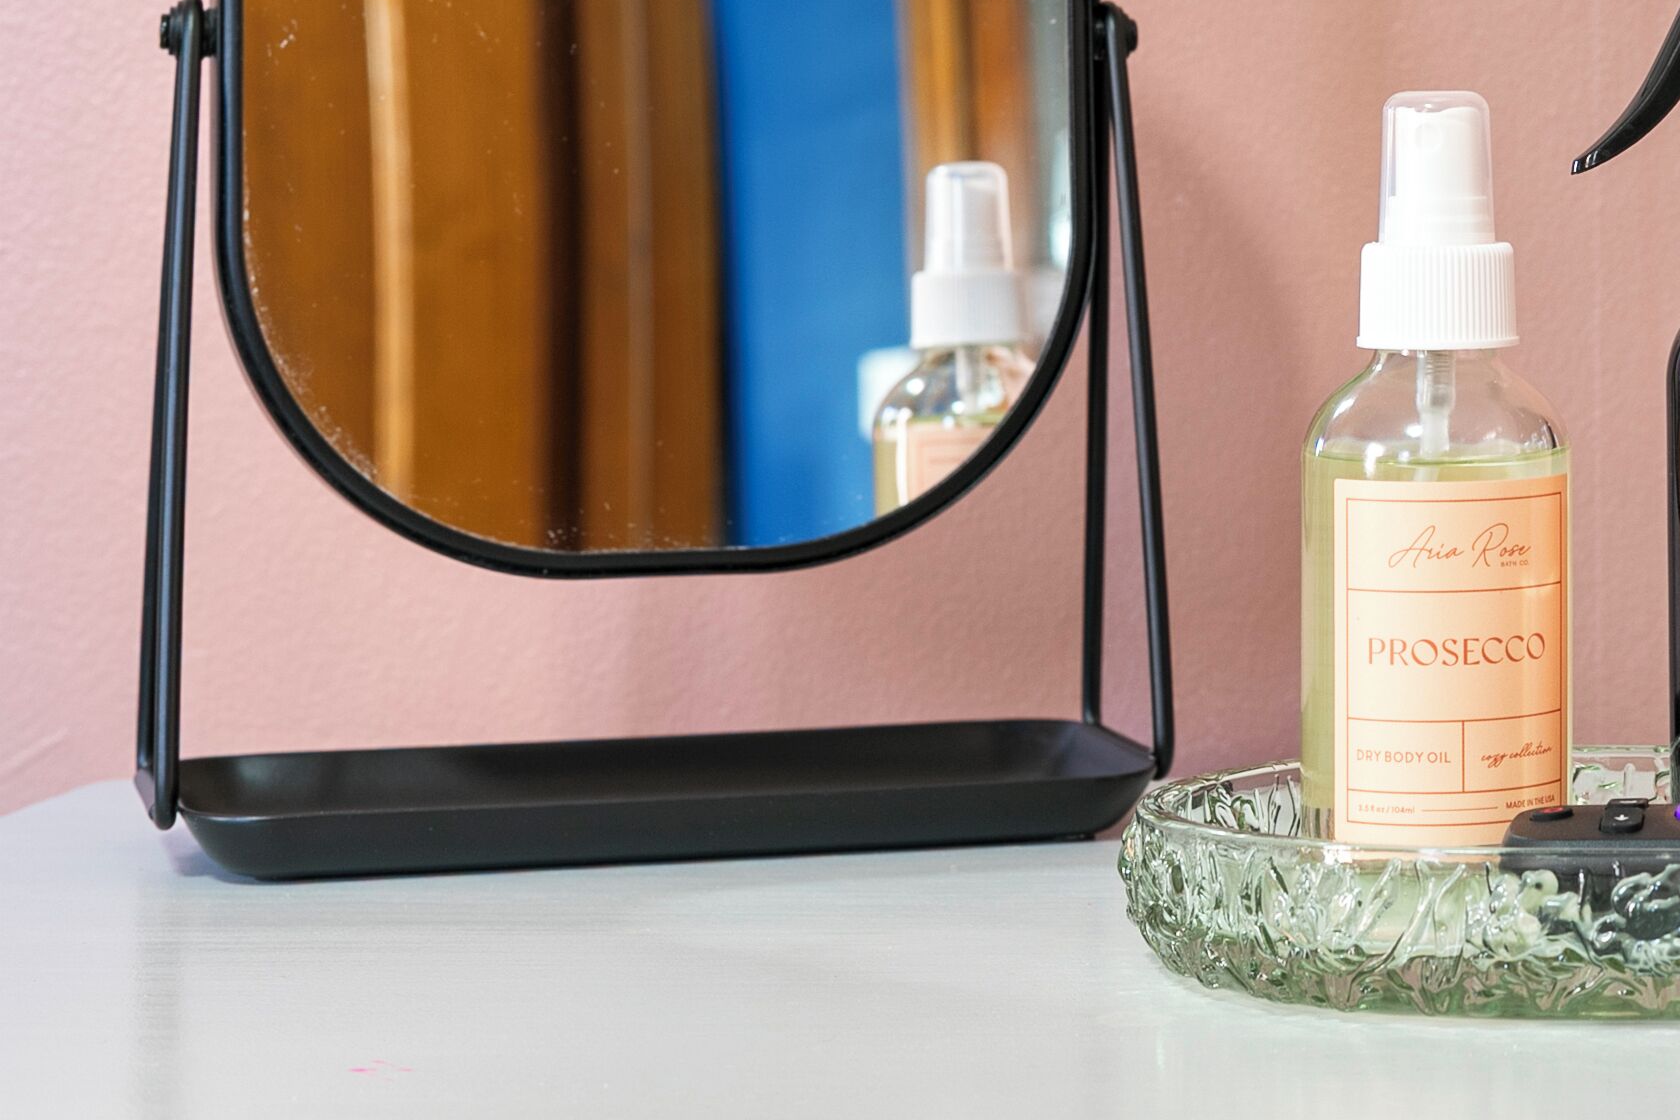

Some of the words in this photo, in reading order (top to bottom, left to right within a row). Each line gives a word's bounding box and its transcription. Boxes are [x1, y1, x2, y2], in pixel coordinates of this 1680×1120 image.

[1389, 525, 1464, 568] Aria
[1472, 523, 1531, 567] Rose
[1500, 560, 1517, 568] BATH
[1367, 632, 1546, 667] PROSECCO
[1356, 749, 1382, 762] DRY
[1384, 751, 1423, 764] BODY
[1427, 751, 1451, 764] OIL
[1508, 741, 1553, 760] collection
[1505, 799, 1526, 809] MADE
